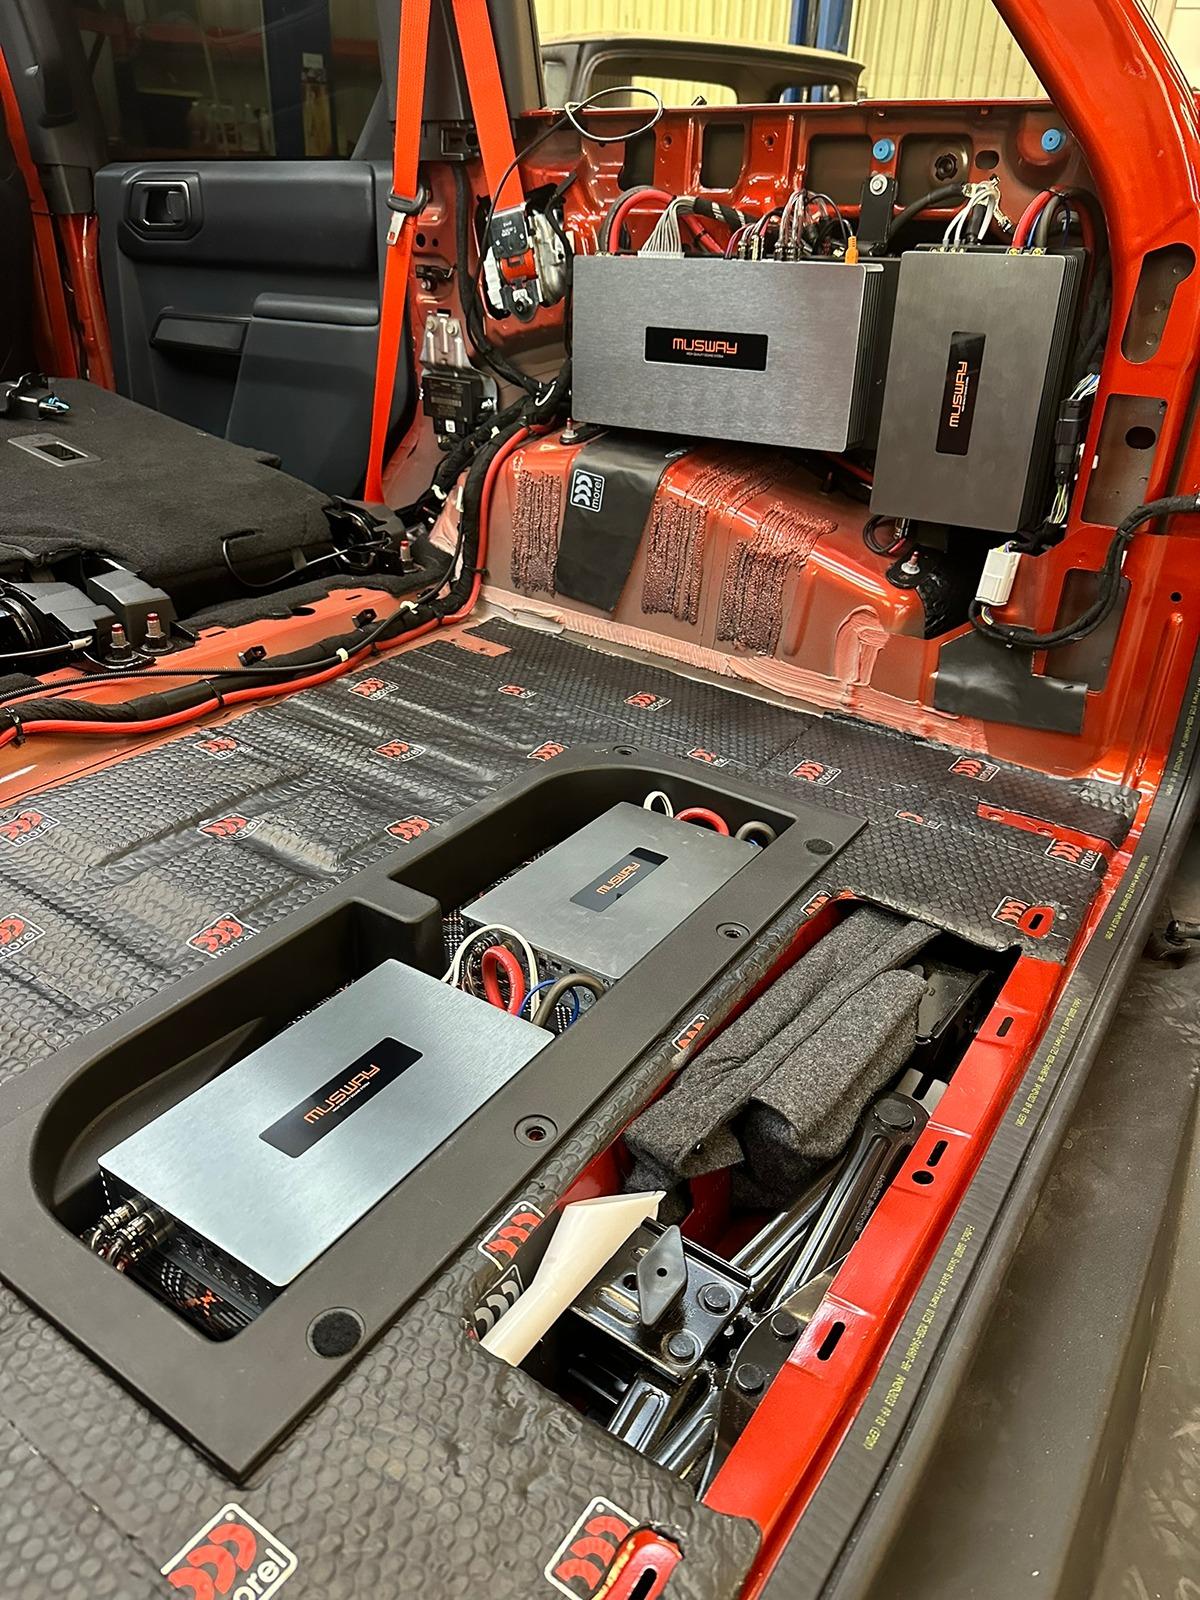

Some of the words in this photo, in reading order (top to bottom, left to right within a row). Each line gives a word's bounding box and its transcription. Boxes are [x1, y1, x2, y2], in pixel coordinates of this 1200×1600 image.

[673, 338, 737, 355] MUSWAY
[949, 361, 967, 427] MUSWAY
[592, 477, 602, 509] morel
[14, 818, 56, 845] morel
[1080, 849, 1097, 869] more
[596, 861, 641, 895] MUSWAY
[303, 1063, 381, 1124] MUSWAY
[232, 1547, 288, 1600] orel
